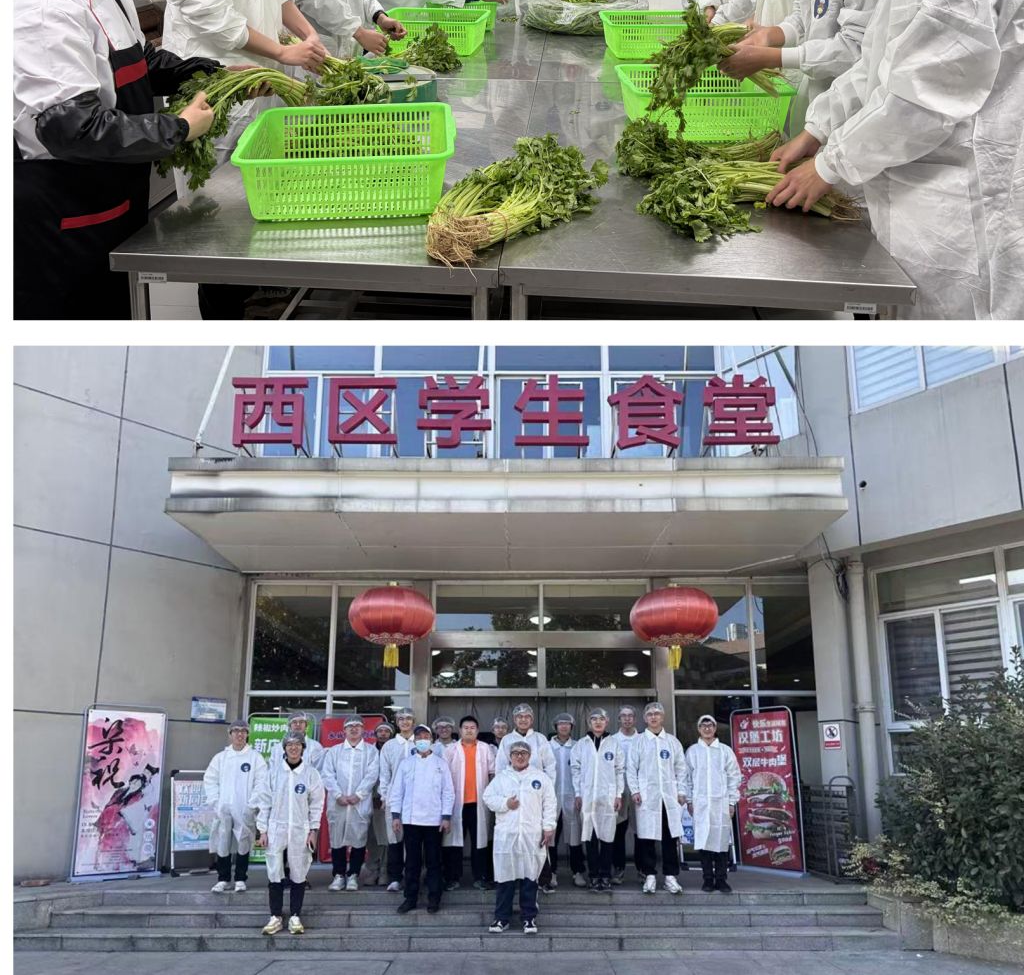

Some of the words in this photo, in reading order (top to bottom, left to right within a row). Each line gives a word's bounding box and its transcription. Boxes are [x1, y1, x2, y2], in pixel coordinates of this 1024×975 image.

[232, 374, 780, 450] 西区学生食堂
[738, 729, 783, 745] 汉堡工坊
